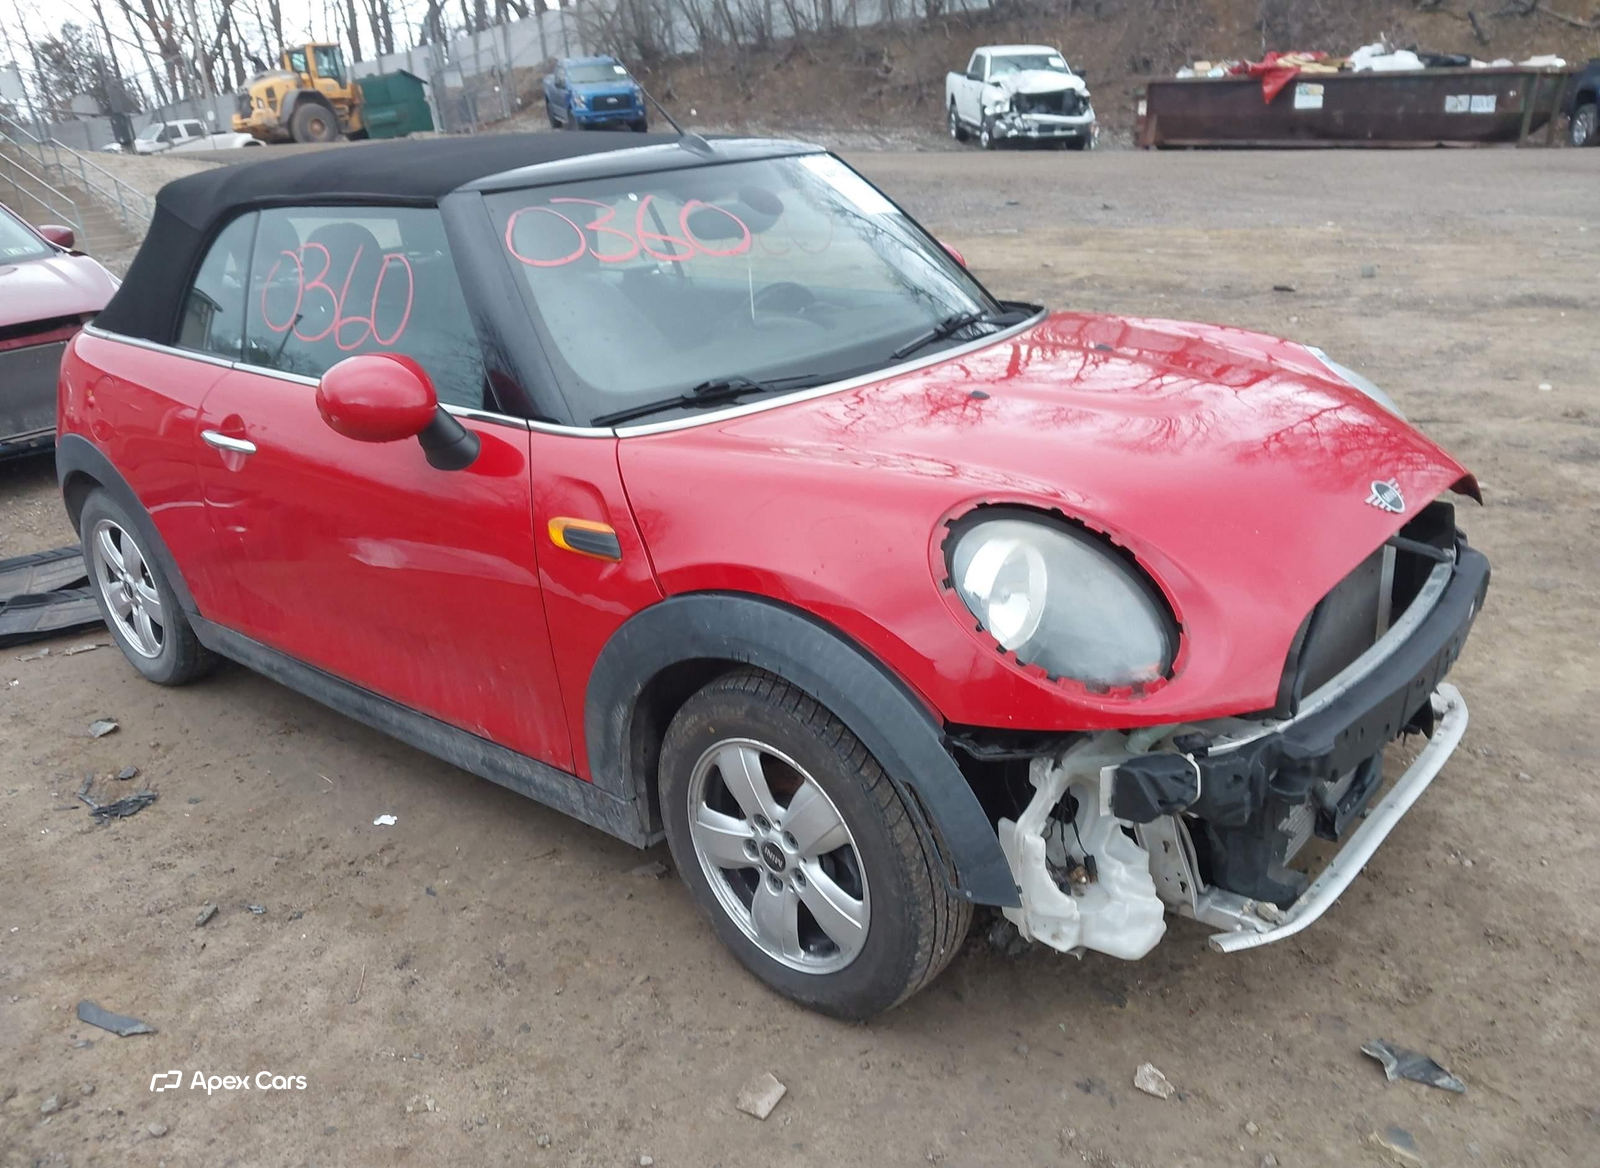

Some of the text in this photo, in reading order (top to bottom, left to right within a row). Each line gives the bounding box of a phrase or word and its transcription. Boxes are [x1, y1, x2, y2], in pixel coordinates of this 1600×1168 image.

[505, 194, 752, 267] 0360
[261, 242, 414, 350] 0360
[764, 846, 783, 868] MINI
